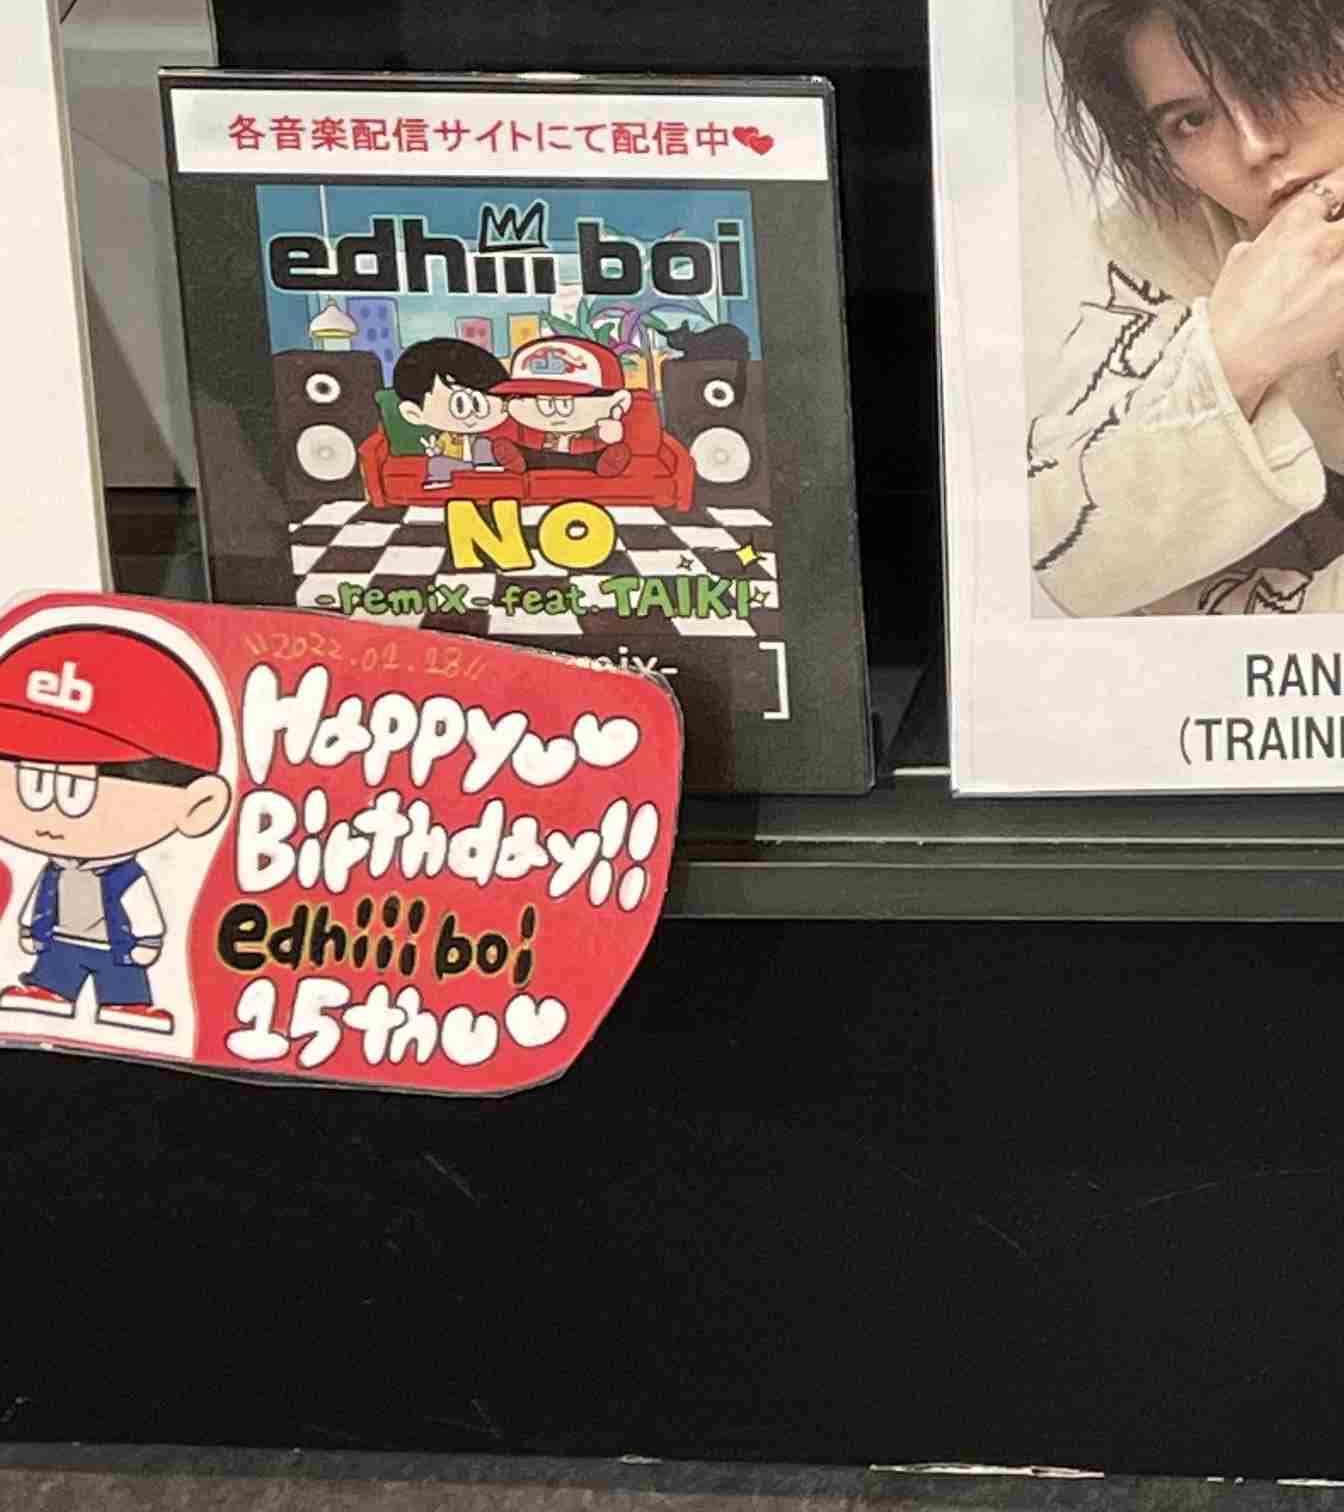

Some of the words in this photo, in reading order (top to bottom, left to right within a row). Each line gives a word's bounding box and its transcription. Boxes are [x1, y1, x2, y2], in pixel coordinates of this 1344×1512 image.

[228, 114, 731, 157] 各音楽配信サイトにて配信中
[576, 217, 747, 300] boi
[443, 498, 620, 572] NO
[601, 575, 752, 620] TAIKI
[1246, 653, 1342, 697] RAN
[242, 663, 529, 794] Happy
[217, 894, 427, 977] edhiii
[434, 904, 537, 987] boi
[224, 977, 438, 1069] 15th
